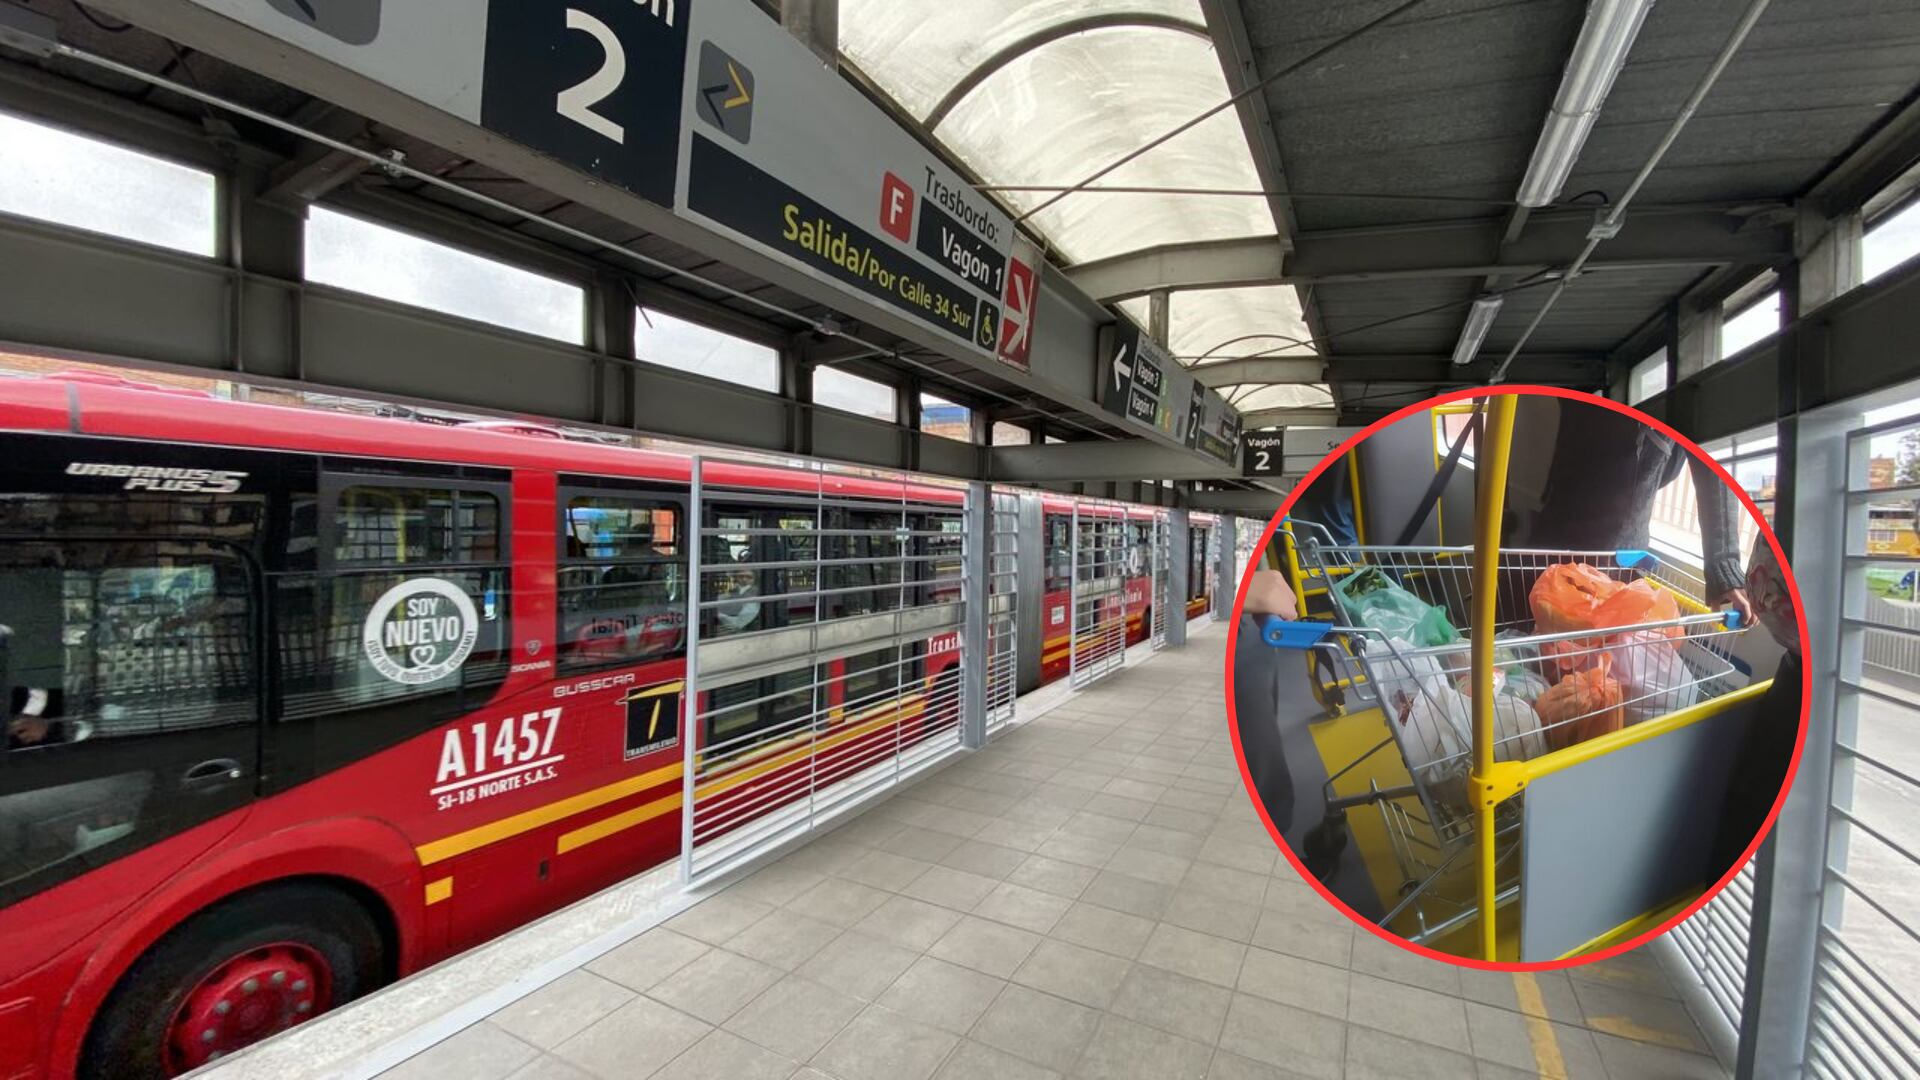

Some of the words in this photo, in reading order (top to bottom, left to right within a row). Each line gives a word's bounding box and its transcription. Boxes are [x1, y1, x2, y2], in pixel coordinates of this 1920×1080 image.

[557, 8, 626, 145] 2
[890, 186, 905, 226] F
[925, 166, 999, 244] Trasbordo:
[942, 226, 995, 285] Vagón
[995, 268, 1002, 292] 1
[900, 276, 931, 310] Calle
[934, 293, 949, 319] 34
[952, 303, 972, 328] Sur
[1247, 436, 1280, 449] Vagón
[1254, 451, 1271, 471] 2
[407, 597, 440, 617] SOY
[386, 616, 461, 647] NUEVO
[553, 673, 636, 698] BUSSCAR
[436, 706, 563, 783] A1457
[437, 787, 476, 811] SI-18
[479, 774, 522, 799] NORTE
[524, 765, 558, 787] S.A.S.
